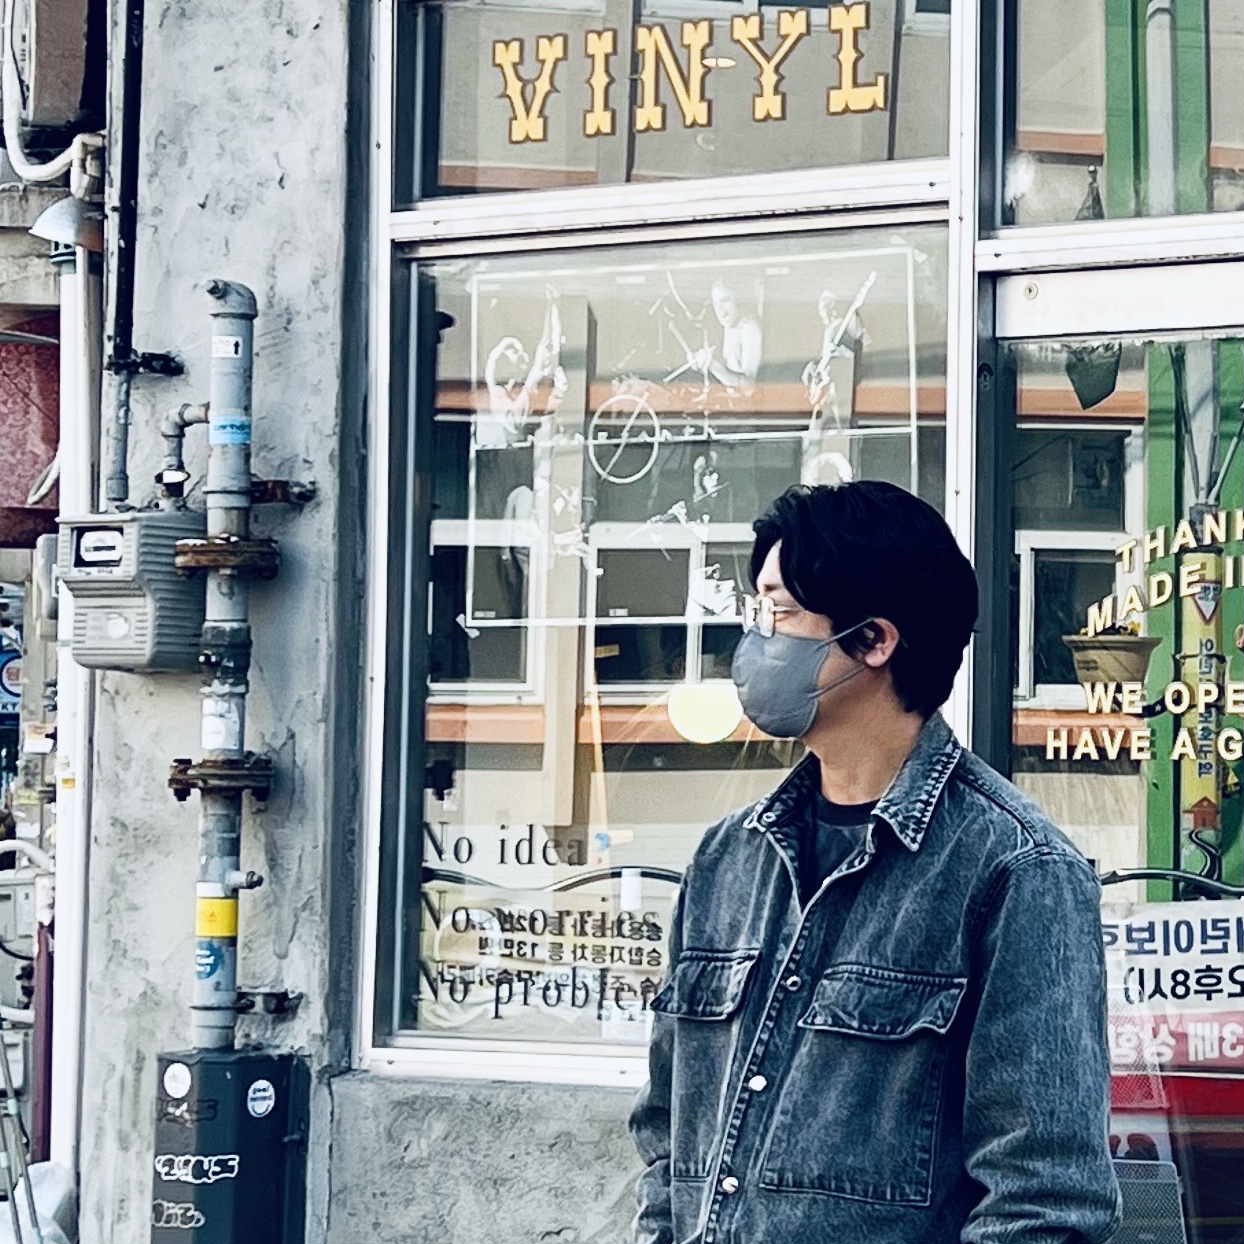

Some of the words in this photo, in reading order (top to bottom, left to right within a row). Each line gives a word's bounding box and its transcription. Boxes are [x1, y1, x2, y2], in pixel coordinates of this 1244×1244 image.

[493, 2, 889, 144] VINYL
[1085, 563, 1203, 638] MADE
[1084, 681, 1145, 714] WE
[1046, 729, 1153, 761] HAVE
[1171, 729, 1198, 761] A
[422, 821, 473, 864] No
[497, 823, 588, 866] idea
[419, 890, 471, 934] No
[494, 896, 660, 938] worries
[414, 960, 471, 1004] No
